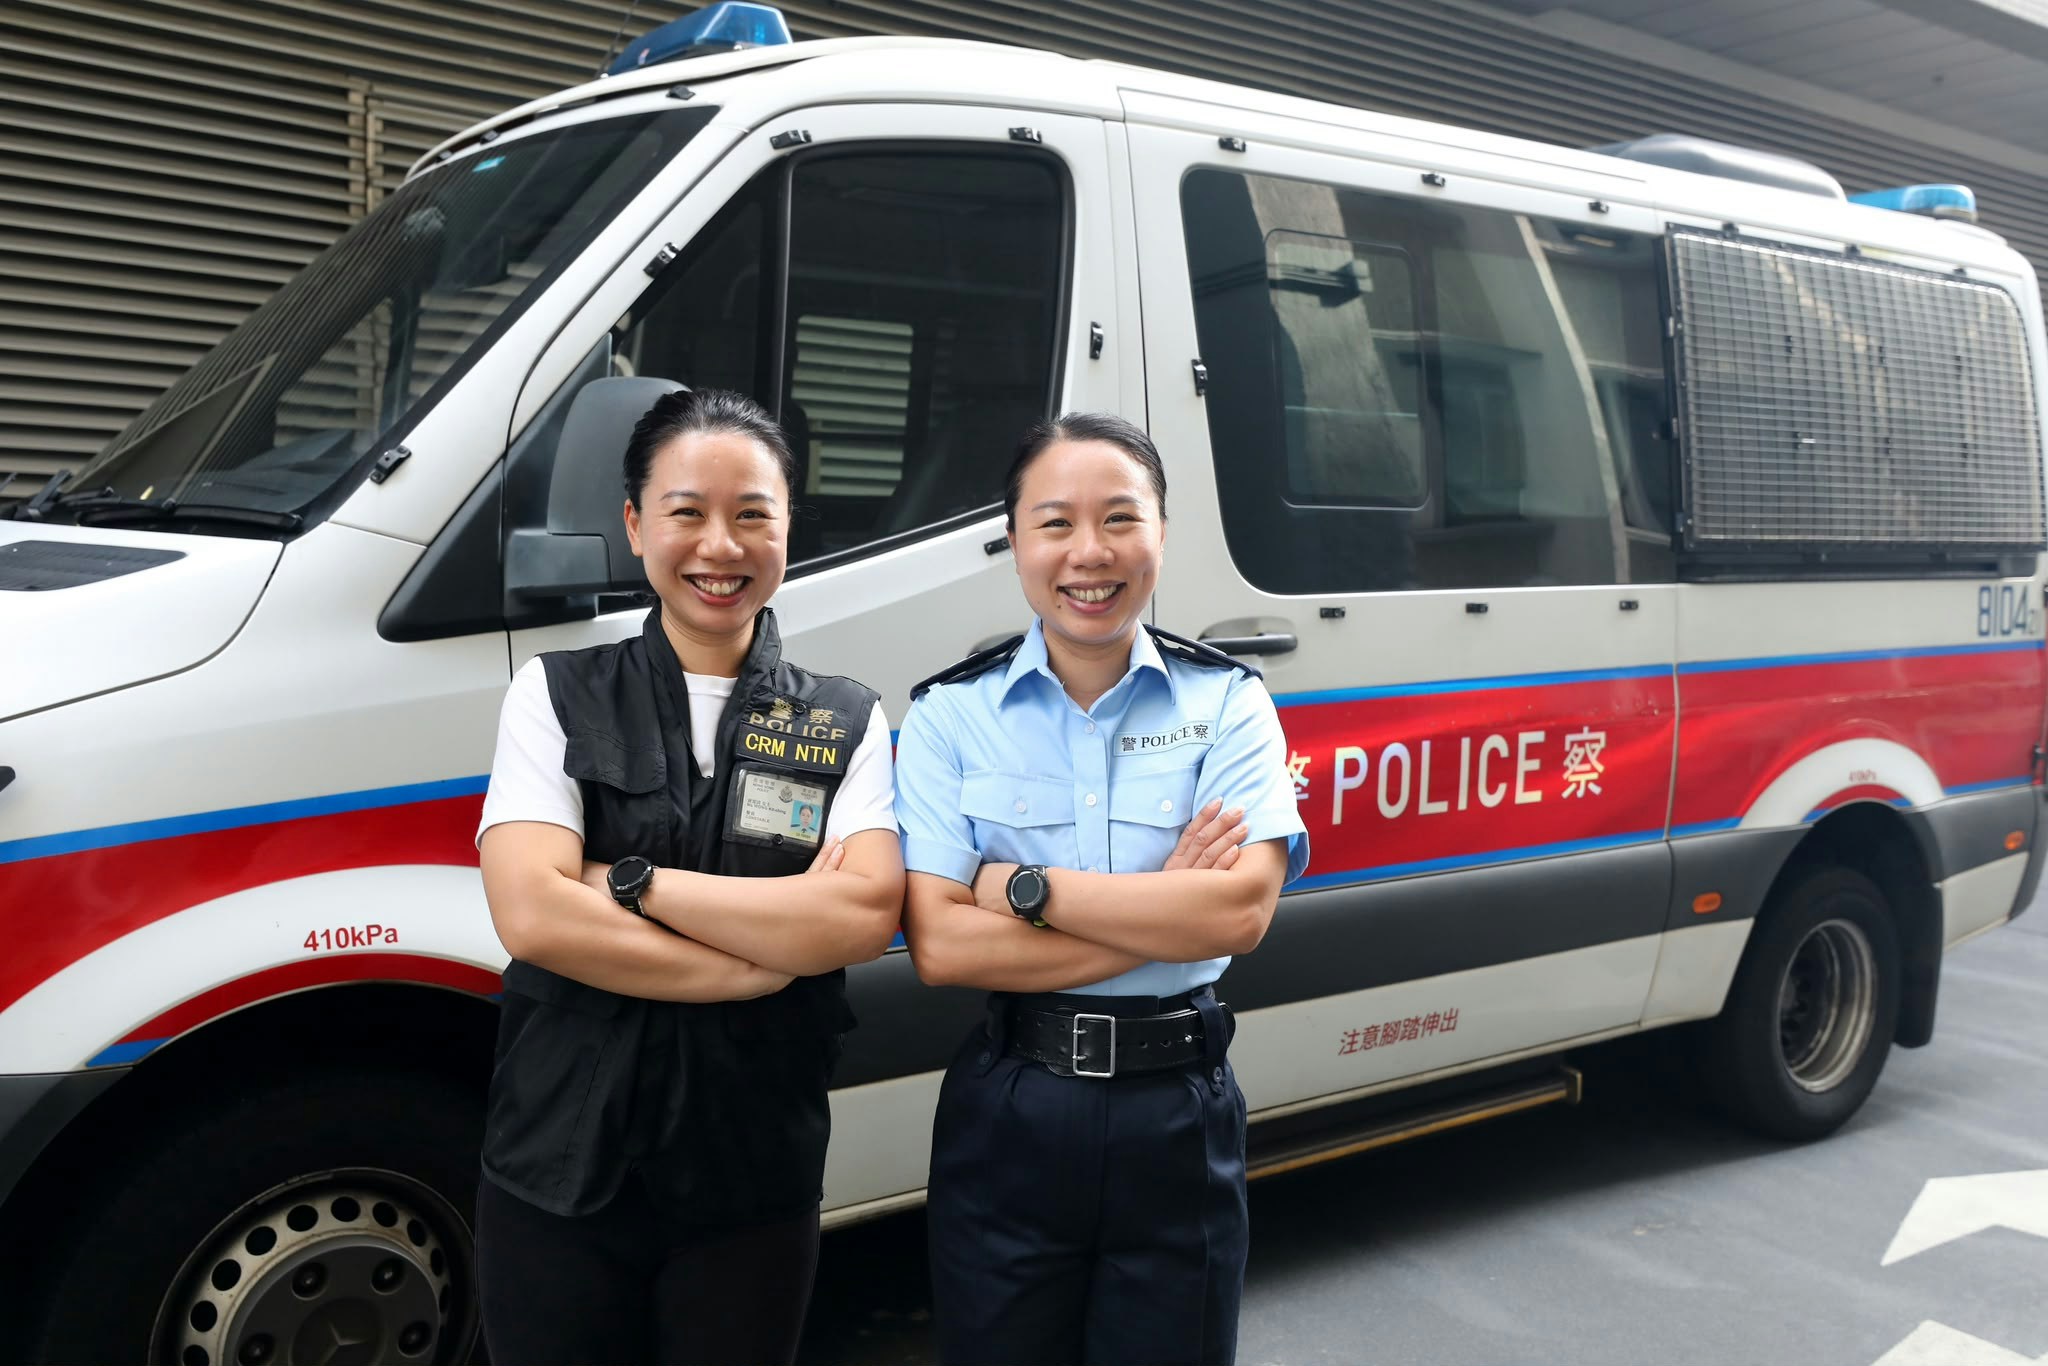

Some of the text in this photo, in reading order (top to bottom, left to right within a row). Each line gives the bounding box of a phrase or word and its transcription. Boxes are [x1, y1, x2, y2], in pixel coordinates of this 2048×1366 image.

[745, 733, 836, 765] CRM NTN
[1140, 726, 1192, 748] POLICE
[1332, 730, 1546, 826] POLICE
[1562, 726, 1607, 799] 察
[303, 924, 399, 952] 410kPa
